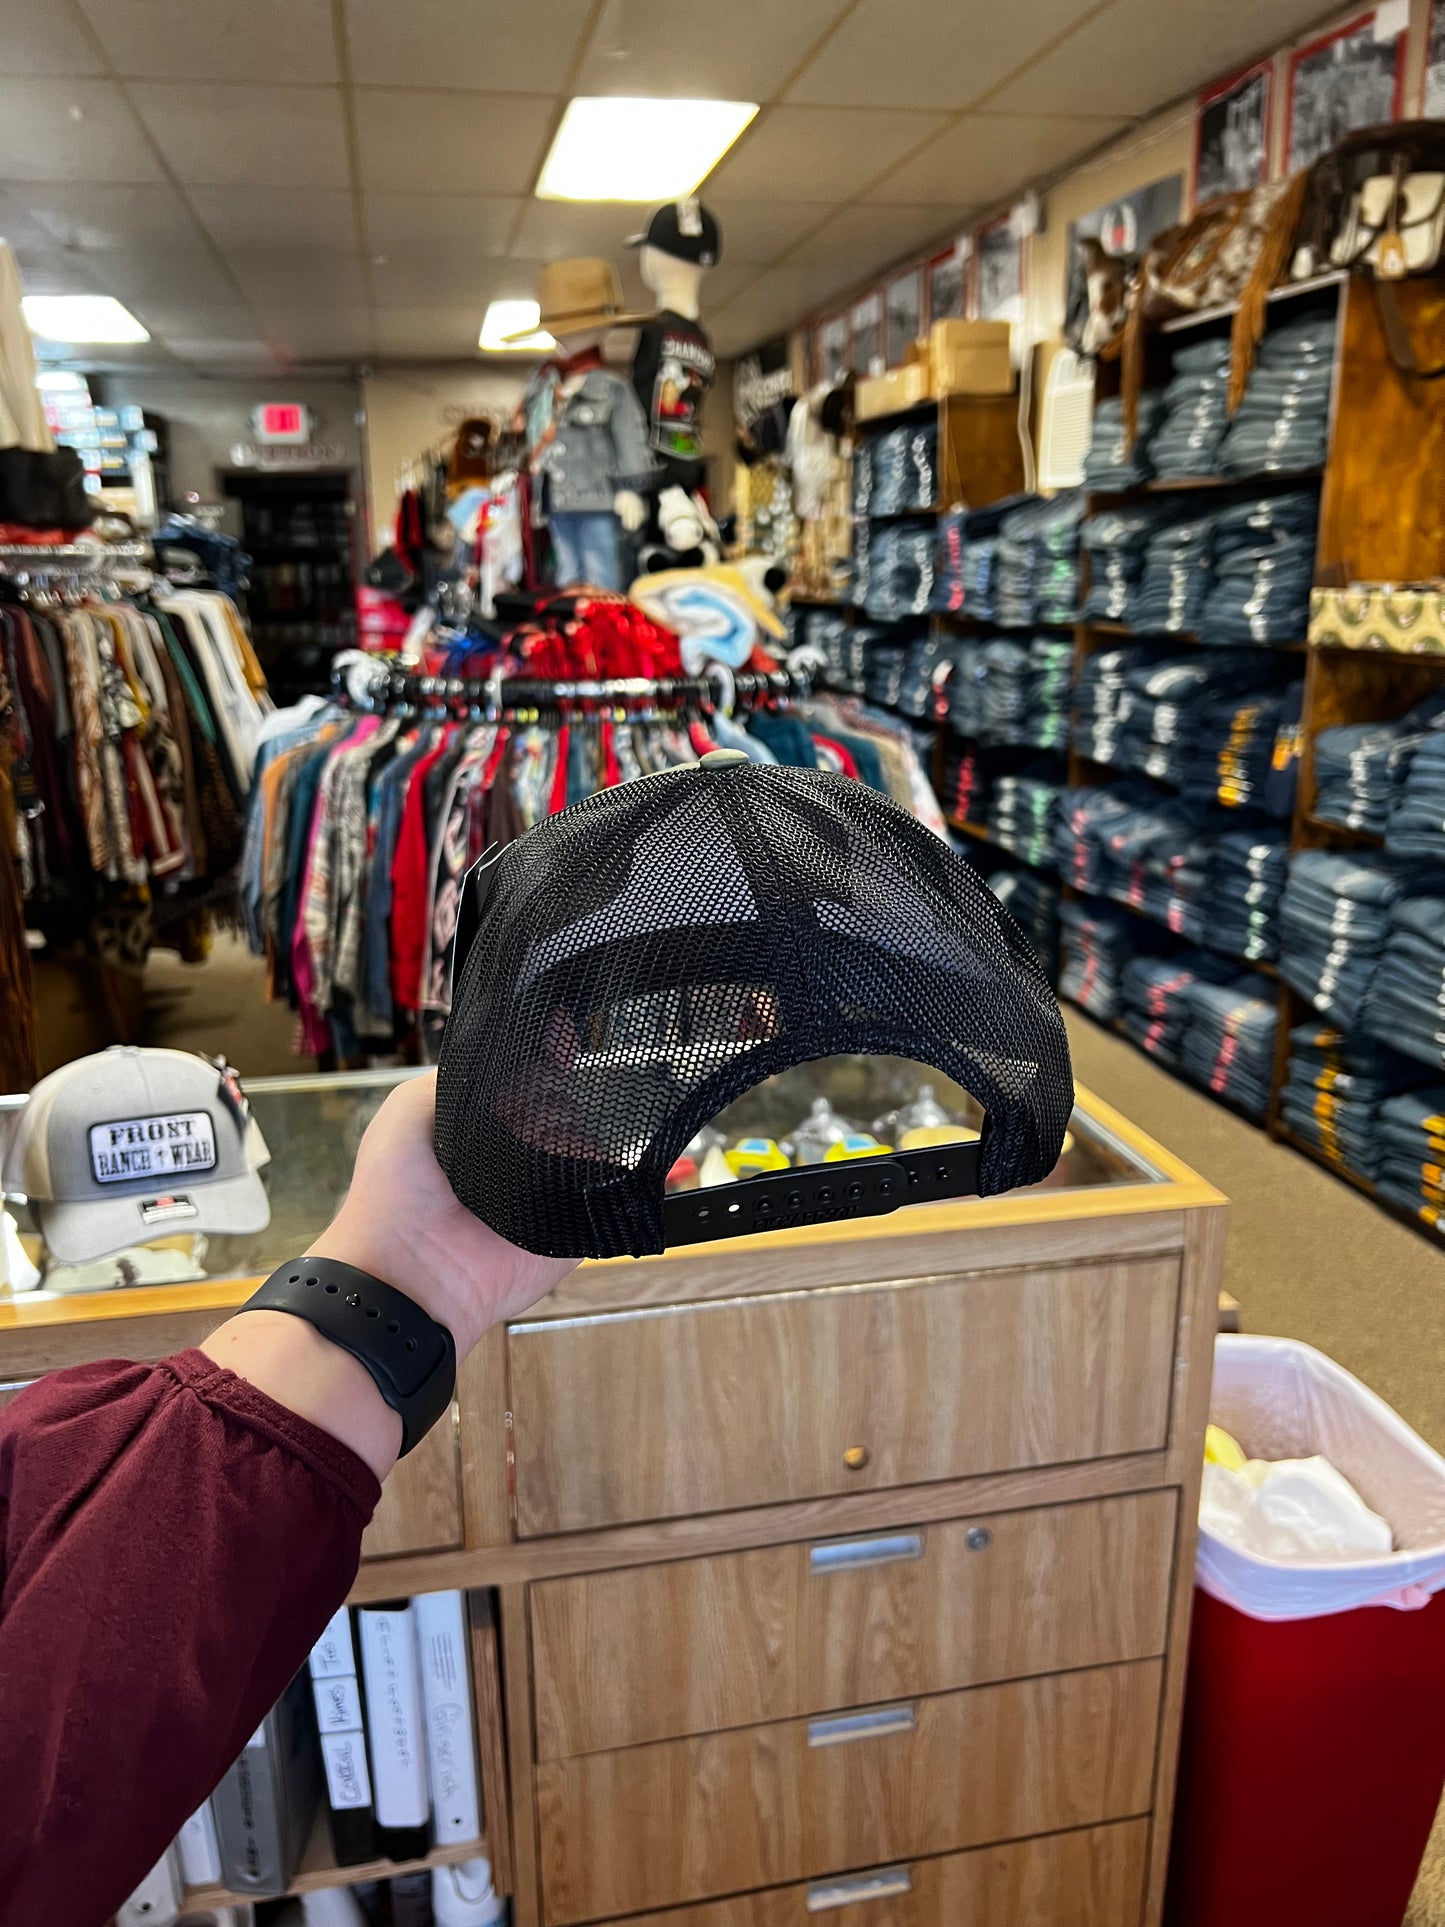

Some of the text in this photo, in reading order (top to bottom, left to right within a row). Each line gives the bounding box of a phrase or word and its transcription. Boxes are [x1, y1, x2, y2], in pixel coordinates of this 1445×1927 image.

[110, 1120, 194, 1146] FROST
[98, 1141, 211, 1176] RANCH WEAR
